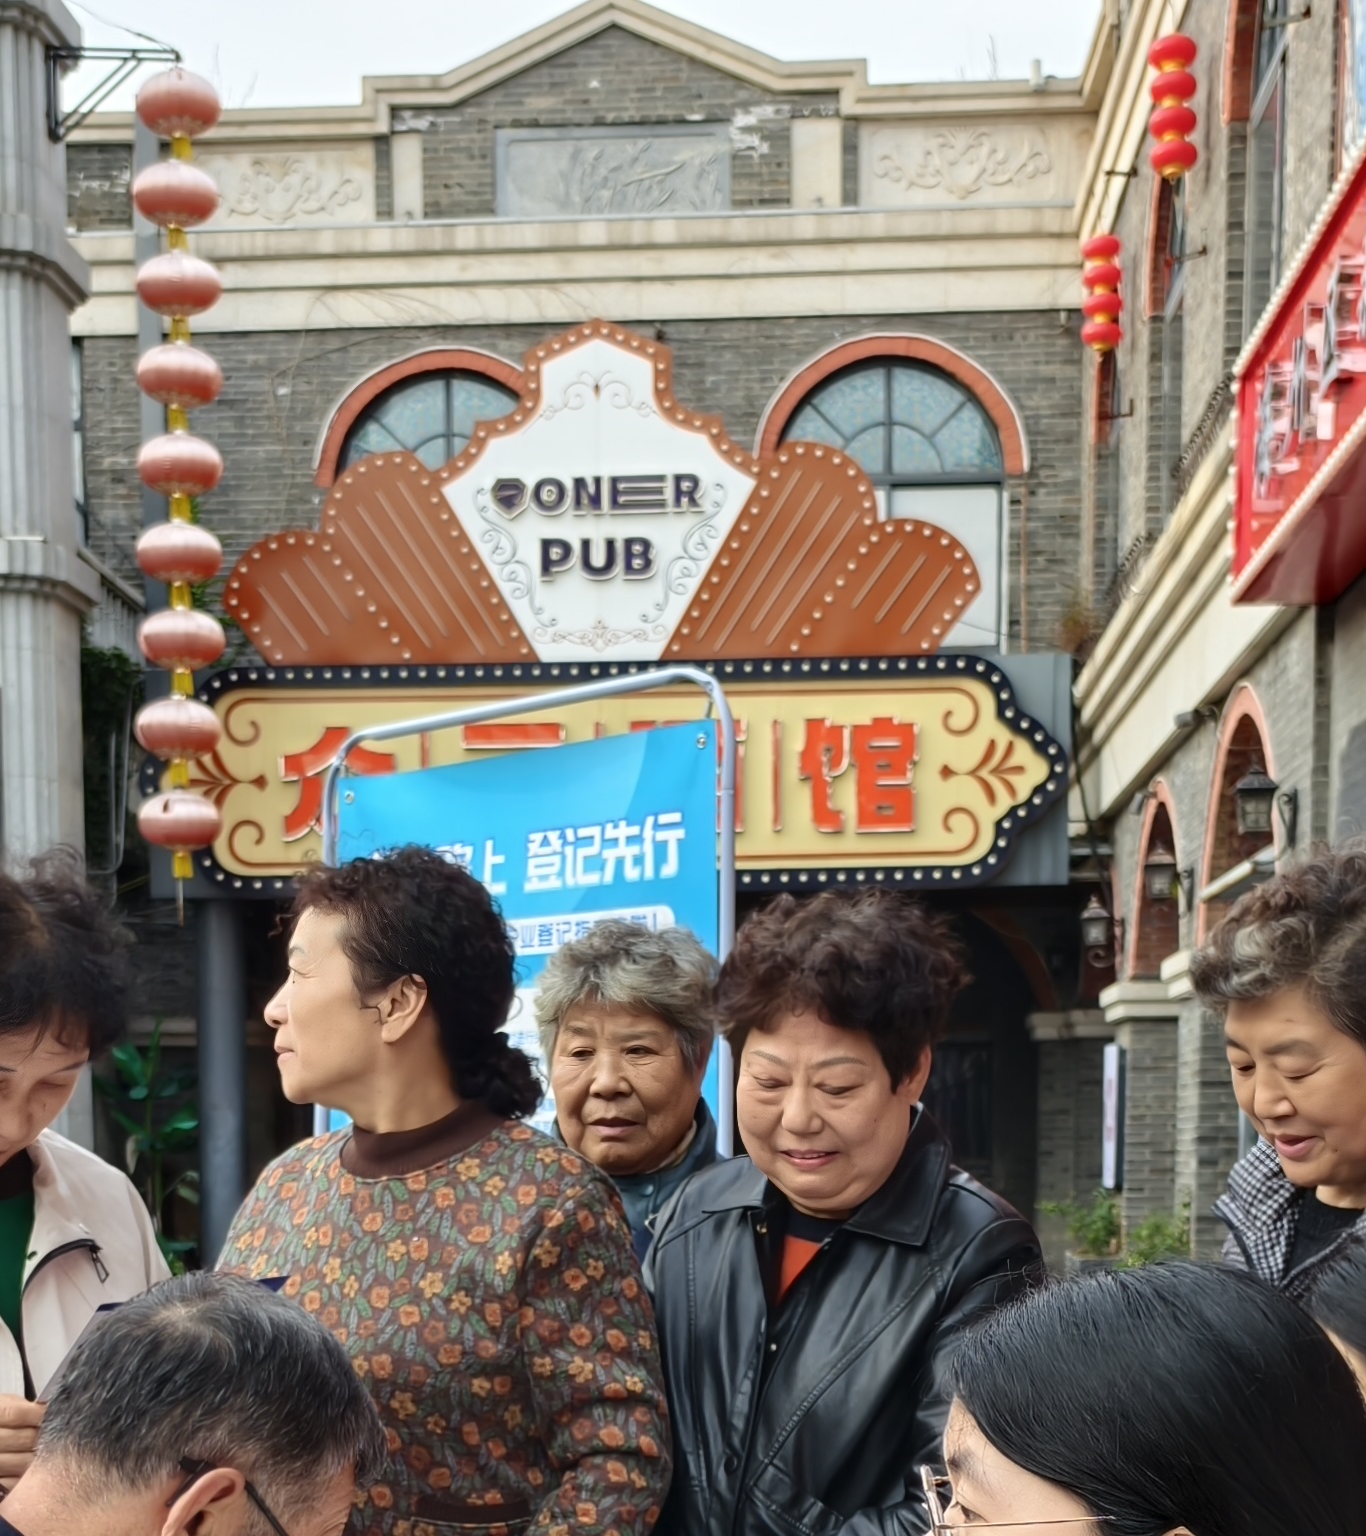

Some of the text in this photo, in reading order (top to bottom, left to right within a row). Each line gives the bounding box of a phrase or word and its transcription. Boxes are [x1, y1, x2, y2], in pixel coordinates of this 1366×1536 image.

[539, 537, 656, 581] PUB
[523, 812, 686, 894] 登记先行
